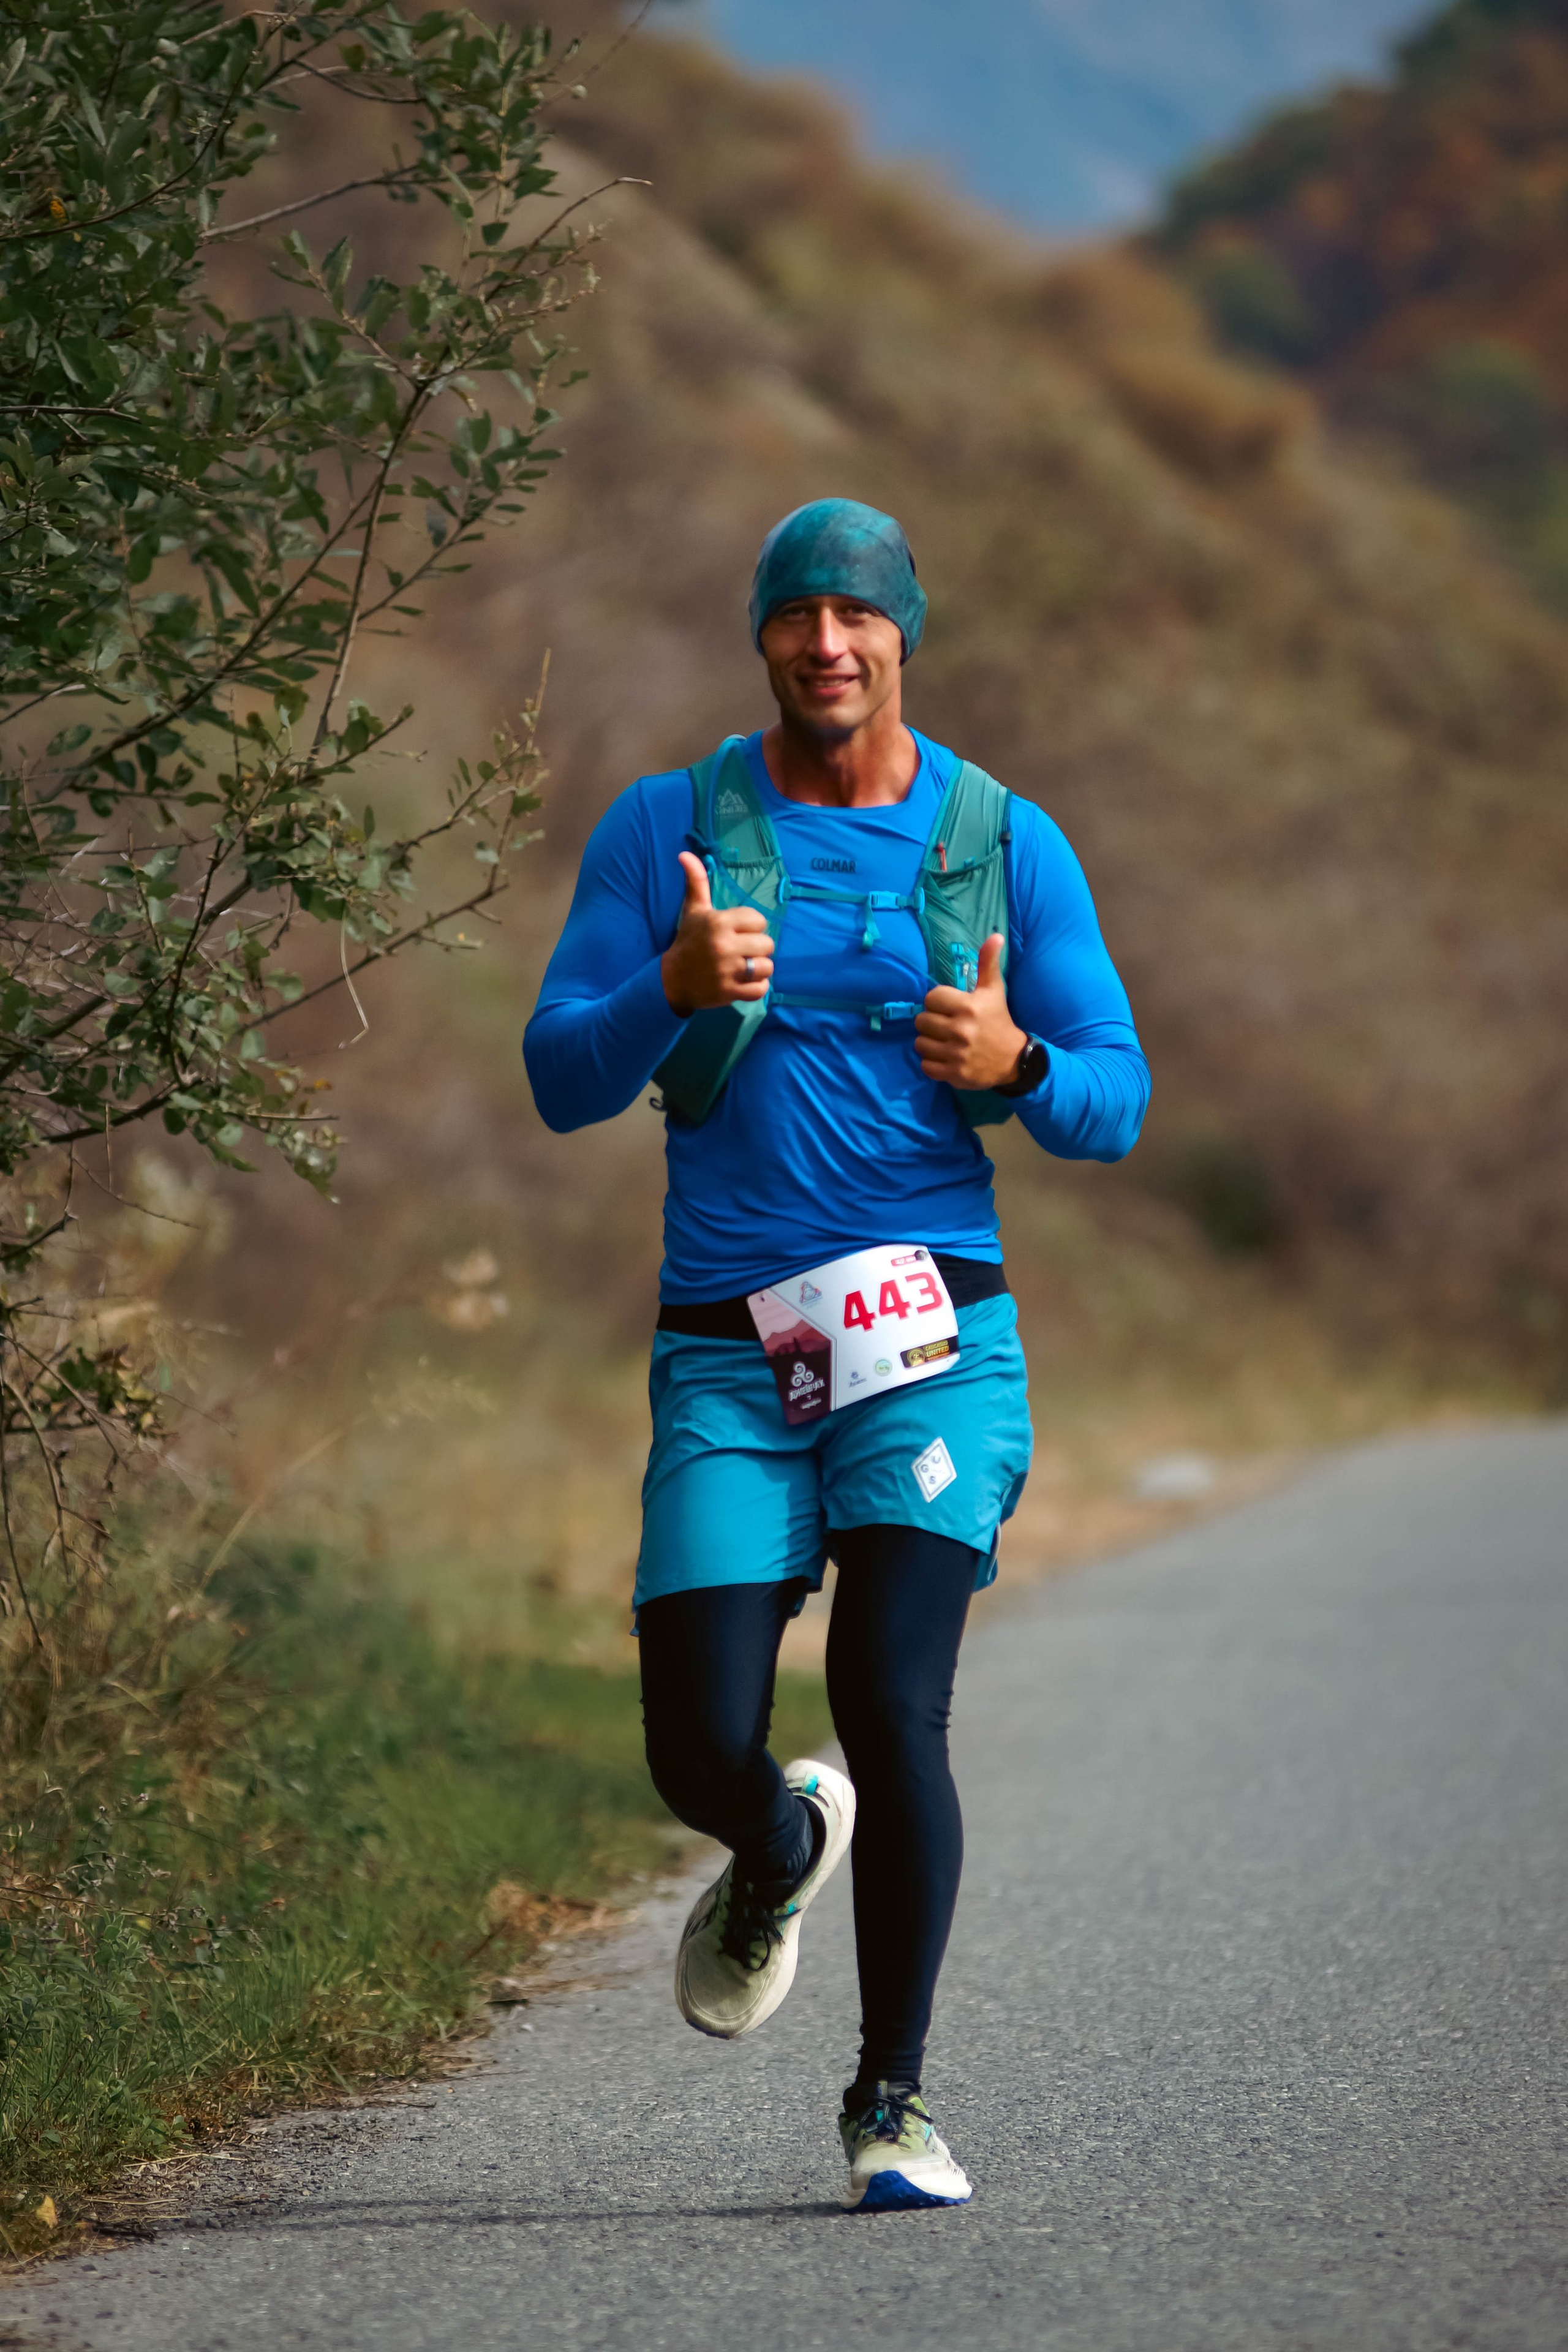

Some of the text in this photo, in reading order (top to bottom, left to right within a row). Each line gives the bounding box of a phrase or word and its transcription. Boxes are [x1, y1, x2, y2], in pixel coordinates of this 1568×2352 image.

[810, 858, 856, 874] COLMAR
[843, 1272, 943, 1332] 443
[925, 1345, 949, 1357] UNITED
